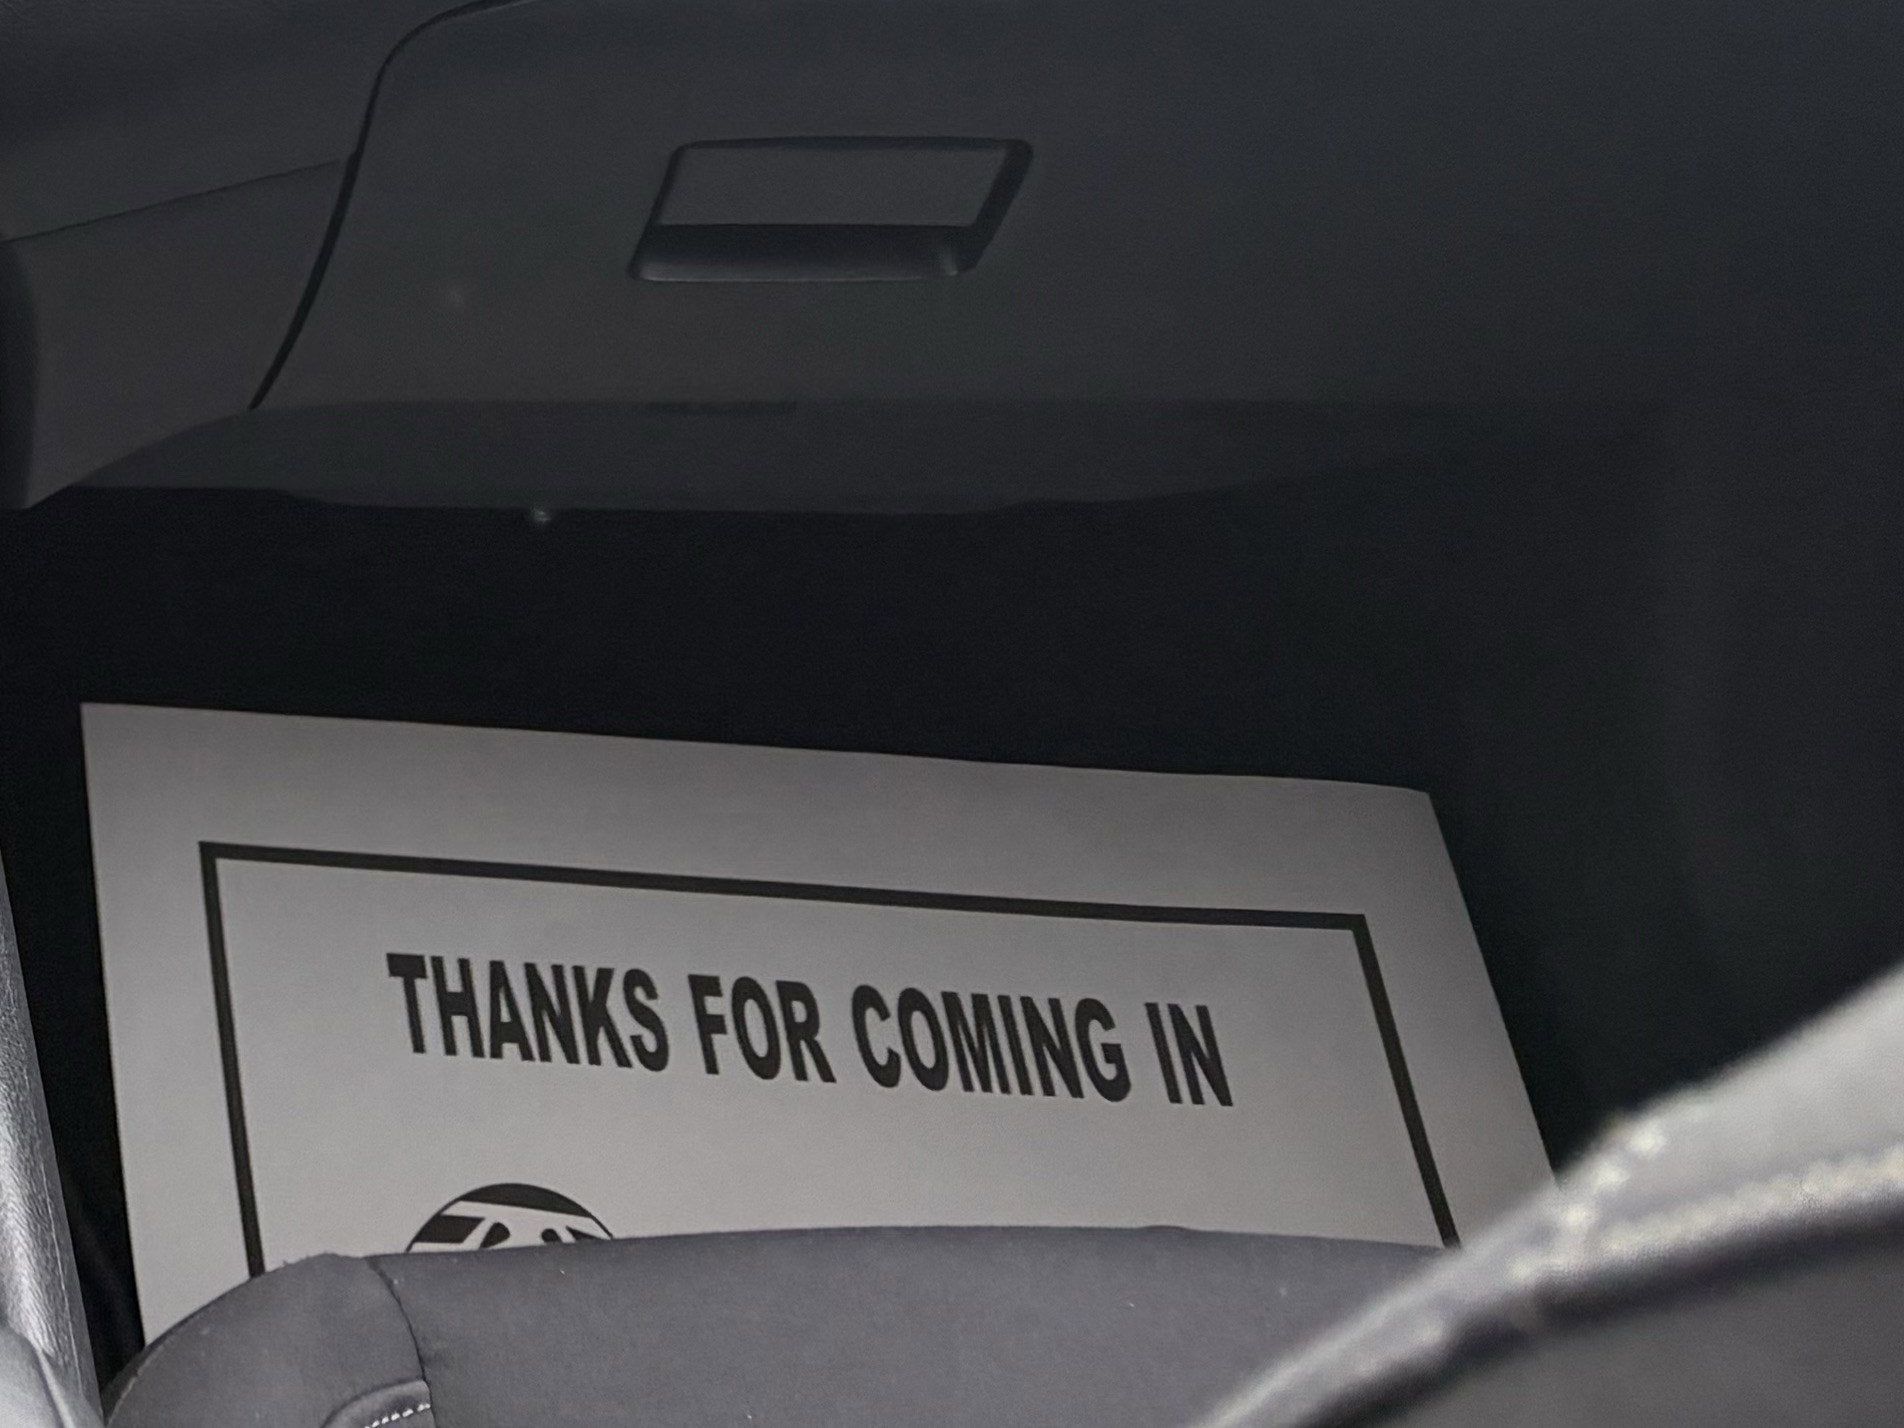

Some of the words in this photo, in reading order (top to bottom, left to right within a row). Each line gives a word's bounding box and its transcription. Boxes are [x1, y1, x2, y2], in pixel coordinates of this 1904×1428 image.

[386, 952, 670, 1072] THANKS
[688, 973, 837, 1083] FOR
[851, 984, 1132, 1103] COMING
[1144, 1002, 1234, 1107] IN
